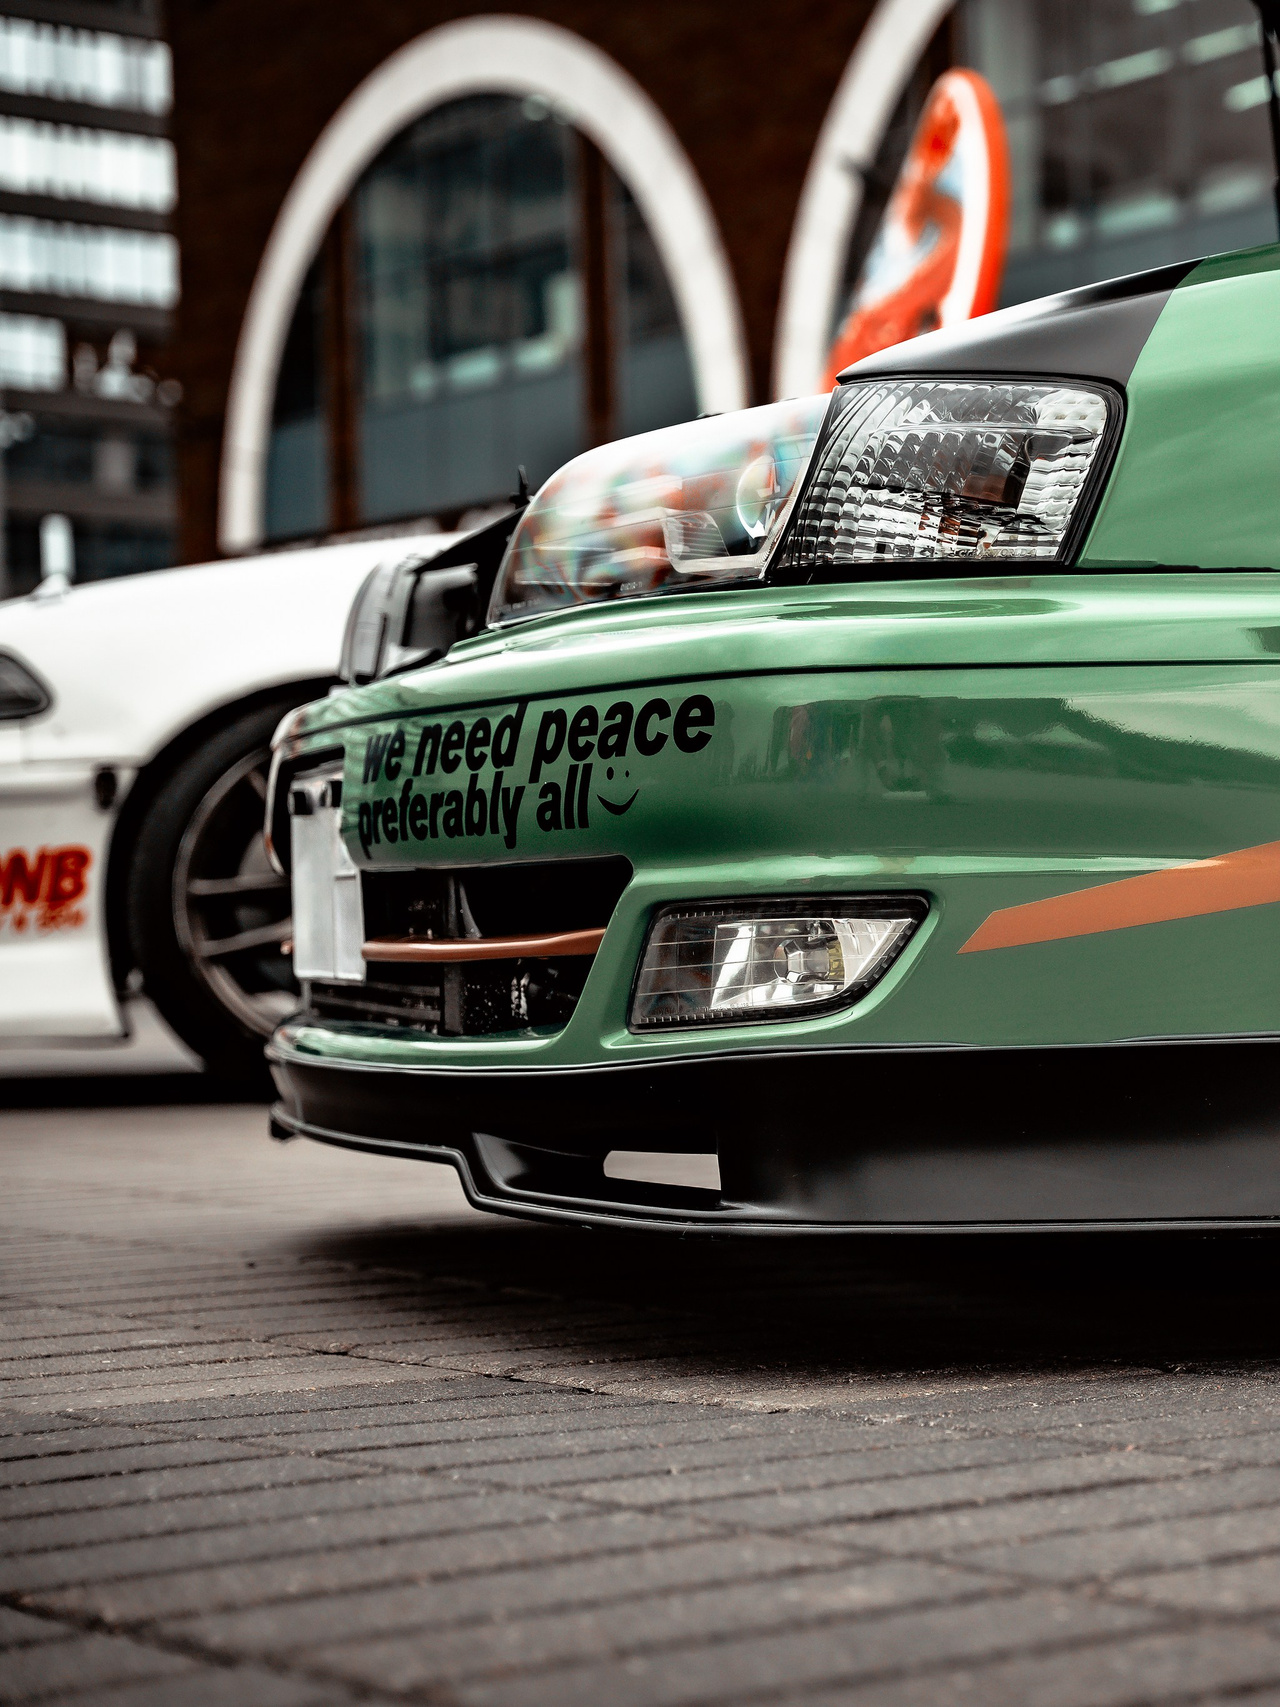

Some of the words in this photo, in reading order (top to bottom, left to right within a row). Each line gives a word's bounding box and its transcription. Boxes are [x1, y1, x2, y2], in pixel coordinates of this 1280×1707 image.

[362, 729, 405, 784] we
[412, 701, 530, 777] need
[528, 694, 715, 784] peace
[358, 770, 526, 860] preferably
[536, 762, 594, 832] all
